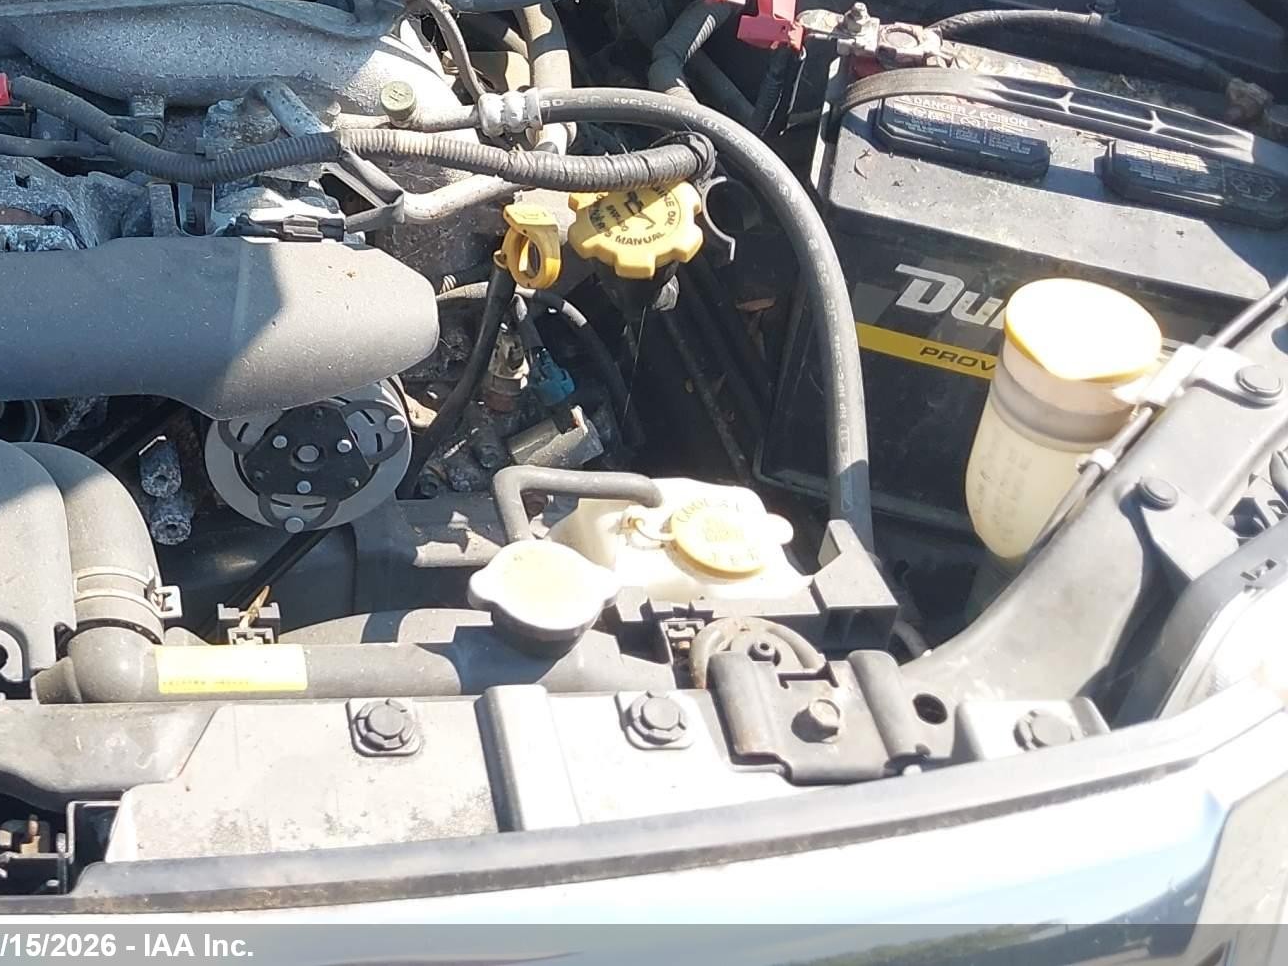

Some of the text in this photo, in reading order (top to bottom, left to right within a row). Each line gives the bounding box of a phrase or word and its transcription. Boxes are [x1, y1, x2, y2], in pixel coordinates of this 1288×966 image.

[913, 96, 967, 115] DANGER
[980, 109, 1029, 127] POISON
[615, 232, 666, 246] MANUAL
